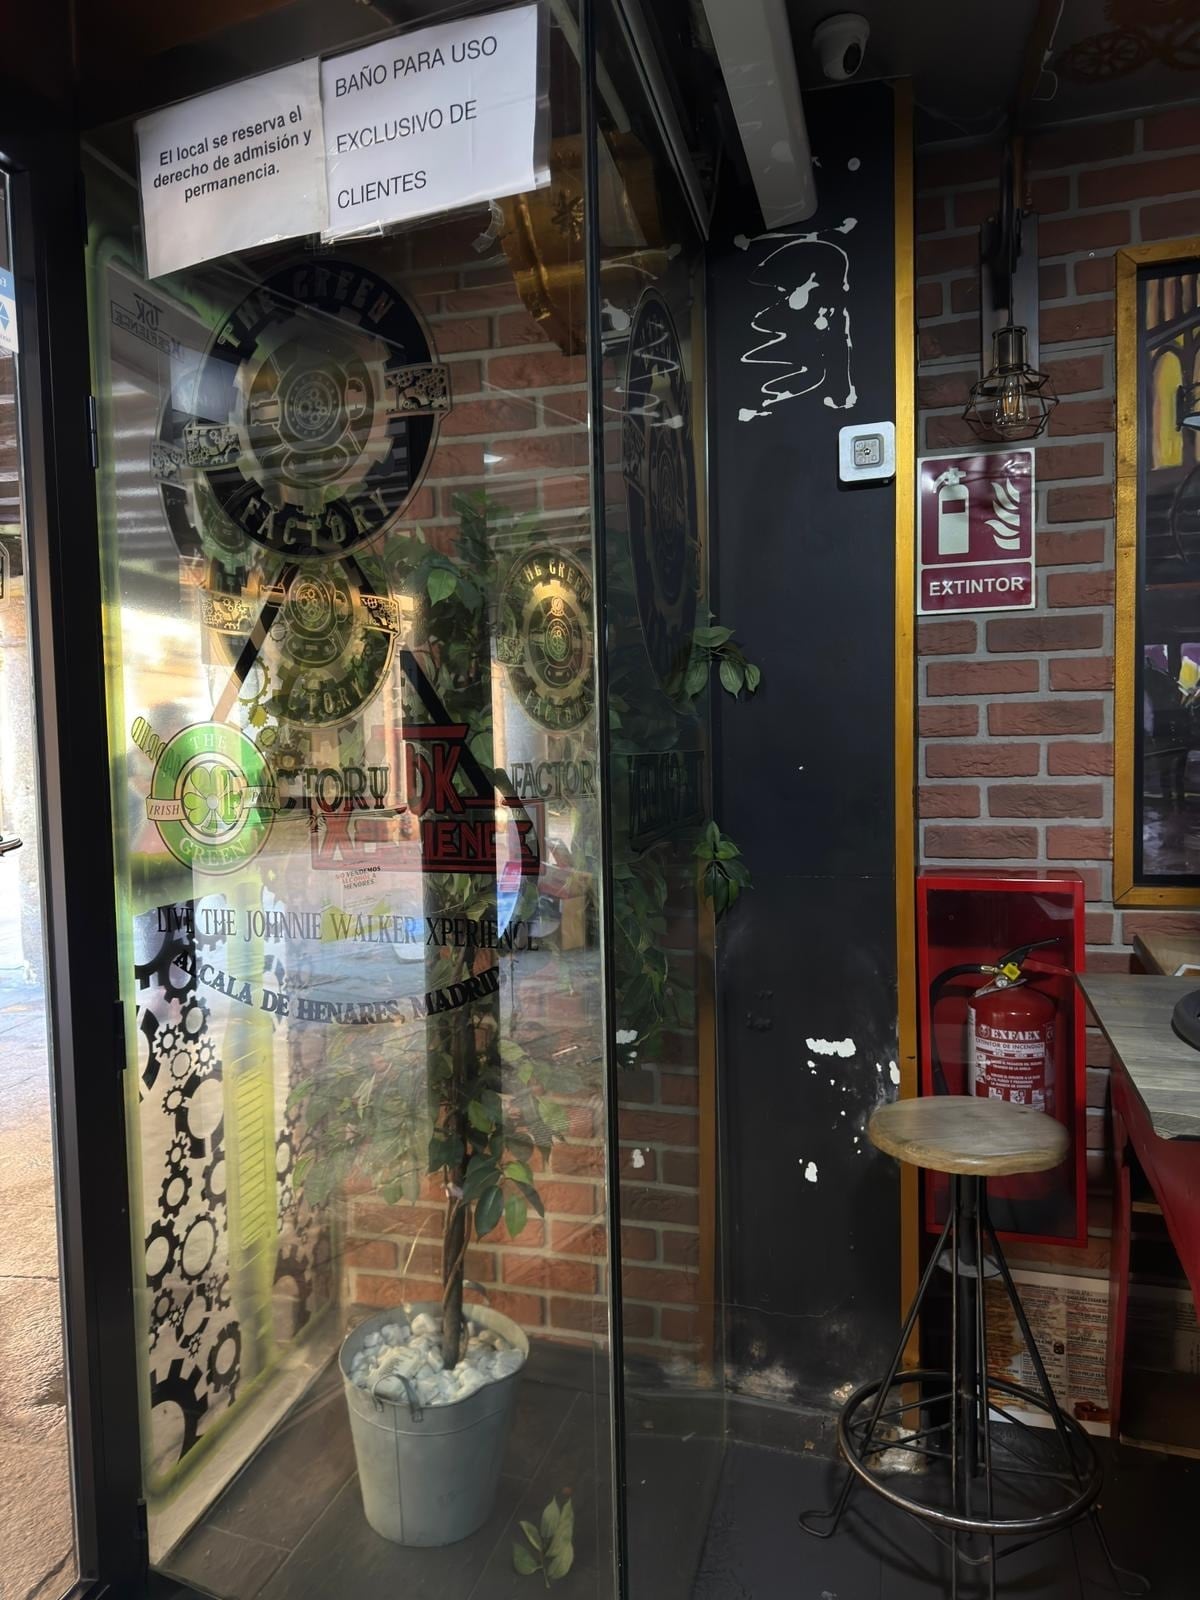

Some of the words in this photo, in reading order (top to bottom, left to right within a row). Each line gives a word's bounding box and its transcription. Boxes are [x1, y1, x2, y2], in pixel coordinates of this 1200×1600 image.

[335, 64, 387, 98] BAÑO
[393, 48, 445, 79] PARA
[451, 36, 498, 63] USO
[159, 149, 173, 166] El
[176, 137, 209, 161] local
[212, 134, 228, 149] se
[231, 115, 287, 143] reserva
[289, 105, 302, 123] el
[336, 108, 443, 154] EXCLUSIVO
[449, 99, 478, 124] DE
[153, 163, 209, 188] derecho
[212, 155, 230, 171] de
[233, 133, 300, 165] admisión
[303, 129, 312, 146] y
[183, 163, 280, 203] permanencia.
[337, 170, 427, 209] CLIENTES
[240, 487, 391, 547] FACTORY
[929, 576, 1024, 597] EXTINTOR
[189, 733, 227, 750] THE
[149, 804, 181, 817] IRISH
[179, 837, 247, 866] GREEN
[320, 816, 535, 862] XIENCE
[201, 908, 237, 936] THE
[244, 910, 322, 942] JOHNNIE
[330, 912, 417, 944] WALKER
[426, 916, 539, 951] XPERIENCE
[260, 988, 290, 1017] DE
[297, 998, 405, 1025] HENARES,
[410, 966, 506, 1020] MADRID
[990, 1028, 1041, 1041] EXFAEX
